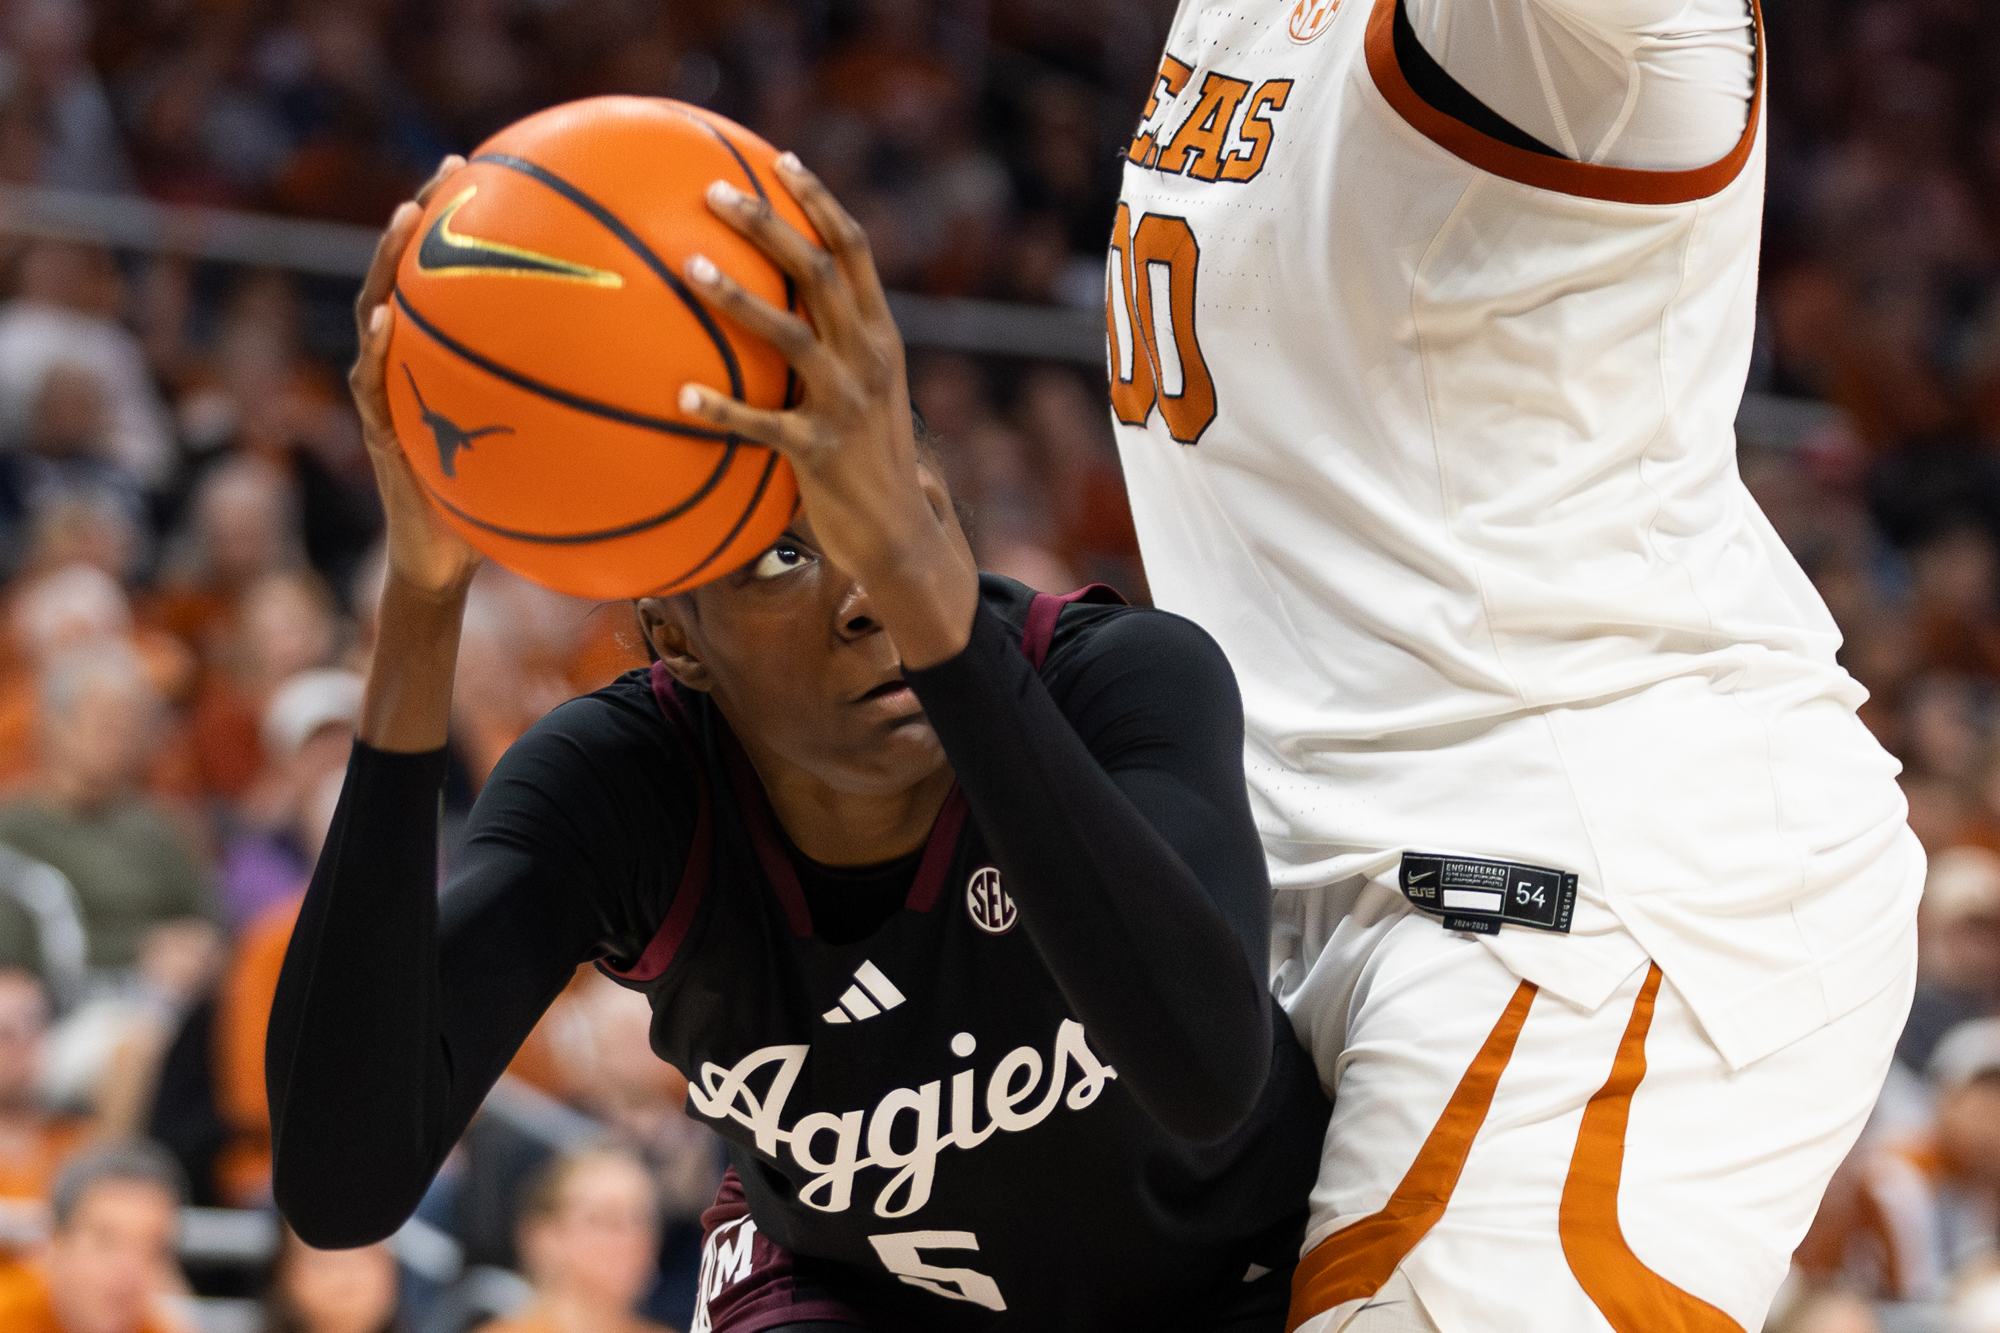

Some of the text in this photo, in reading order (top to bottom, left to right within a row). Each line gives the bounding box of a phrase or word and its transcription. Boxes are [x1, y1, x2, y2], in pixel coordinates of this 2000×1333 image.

[1446, 863, 1505, 877] ENGINEERED
[1516, 881, 1546, 909] 54
[688, 1018, 1118, 1218] Aggies
[867, 1230, 1007, 1311] 5
